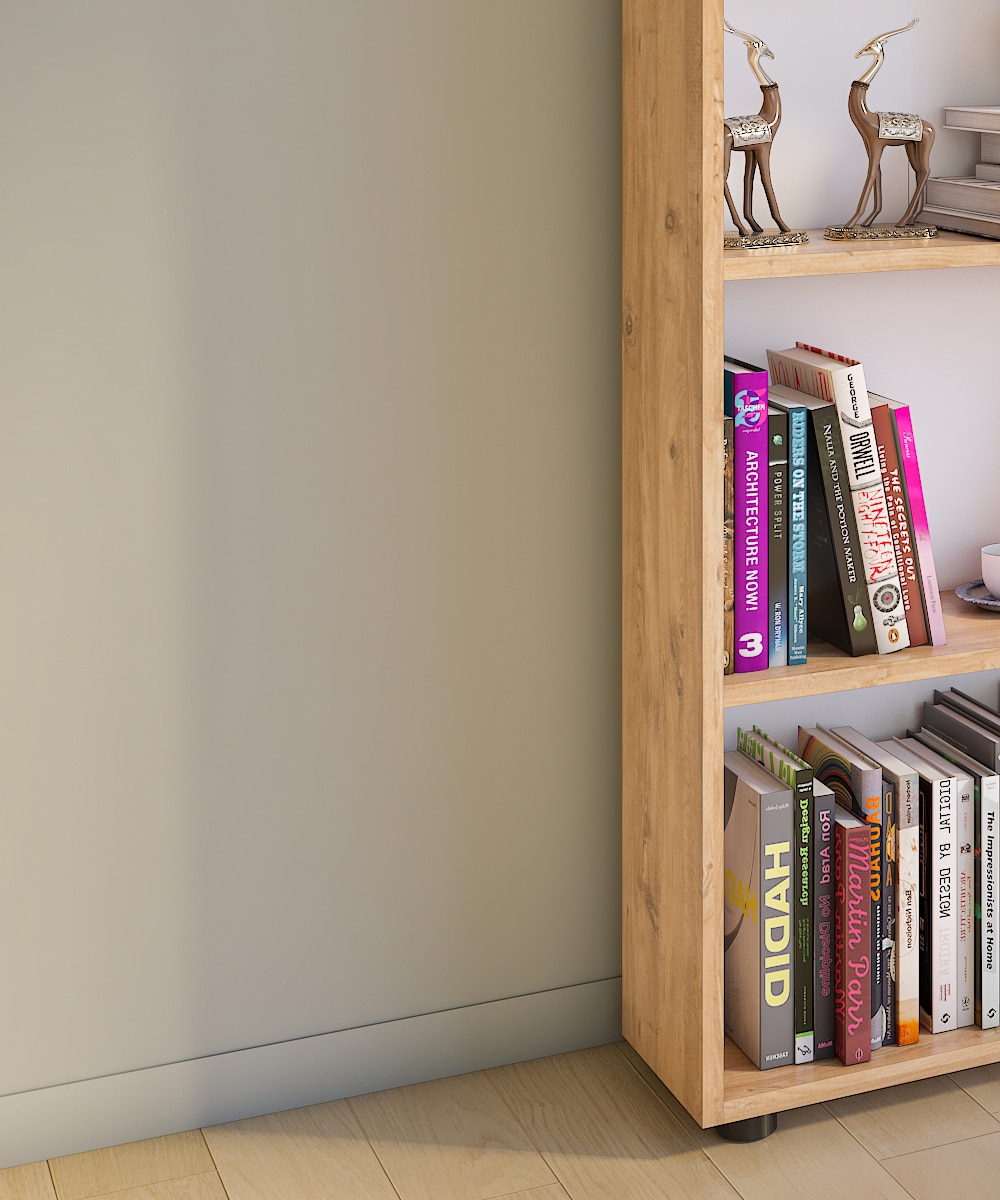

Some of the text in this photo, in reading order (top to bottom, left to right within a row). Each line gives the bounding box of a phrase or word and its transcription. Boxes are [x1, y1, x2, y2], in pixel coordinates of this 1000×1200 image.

[847, 373, 860, 419] GEORGE
[745, 450, 759, 567] ARCHITECTURE
[773, 471, 783, 539] POWER SPLIT
[791, 411, 806, 574] RIDERS ON THE STORM
[849, 431, 876, 480] ORWELL
[829, 459, 857, 583] AND THE POTION MAKER
[878, 445, 912, 612] Living the Pain of Conditional Love
[889, 469, 916, 582] THE SECRETS OUT
[738, 632, 764, 658] 3
[745, 570, 759, 612] NOW!
[774, 612, 782, 626] RON
[847, 842, 870, 1035] Martin Parr
[985, 811, 995, 970] The Impressionists at Home
